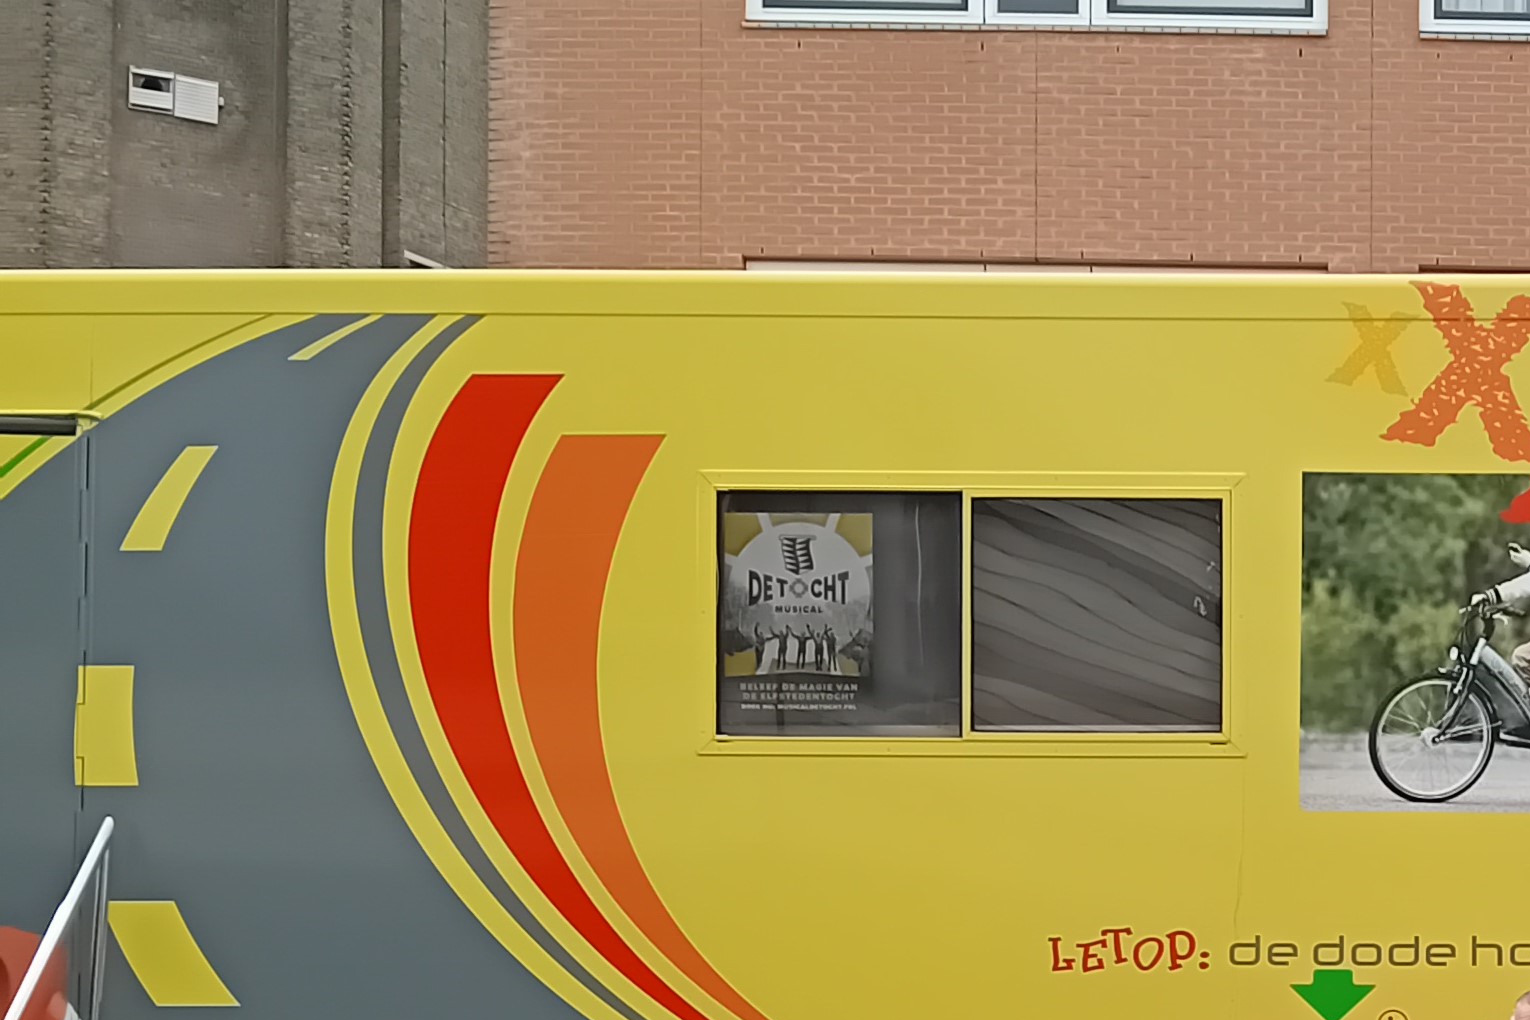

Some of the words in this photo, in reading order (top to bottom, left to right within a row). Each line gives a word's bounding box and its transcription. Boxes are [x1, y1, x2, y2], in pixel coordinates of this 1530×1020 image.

[775, 605, 823, 614] MUSICAL
[739, 683, 778, 691] BELEEF
[782, 683, 796, 691] DE
[799, 683, 833, 692] MAGIE
[836, 683, 859, 692] VAN
[760, 692, 855, 701] ELFSTEDENTOCHT
[1229, 935, 1298, 966] de
[1313, 935, 1456, 967] dode
